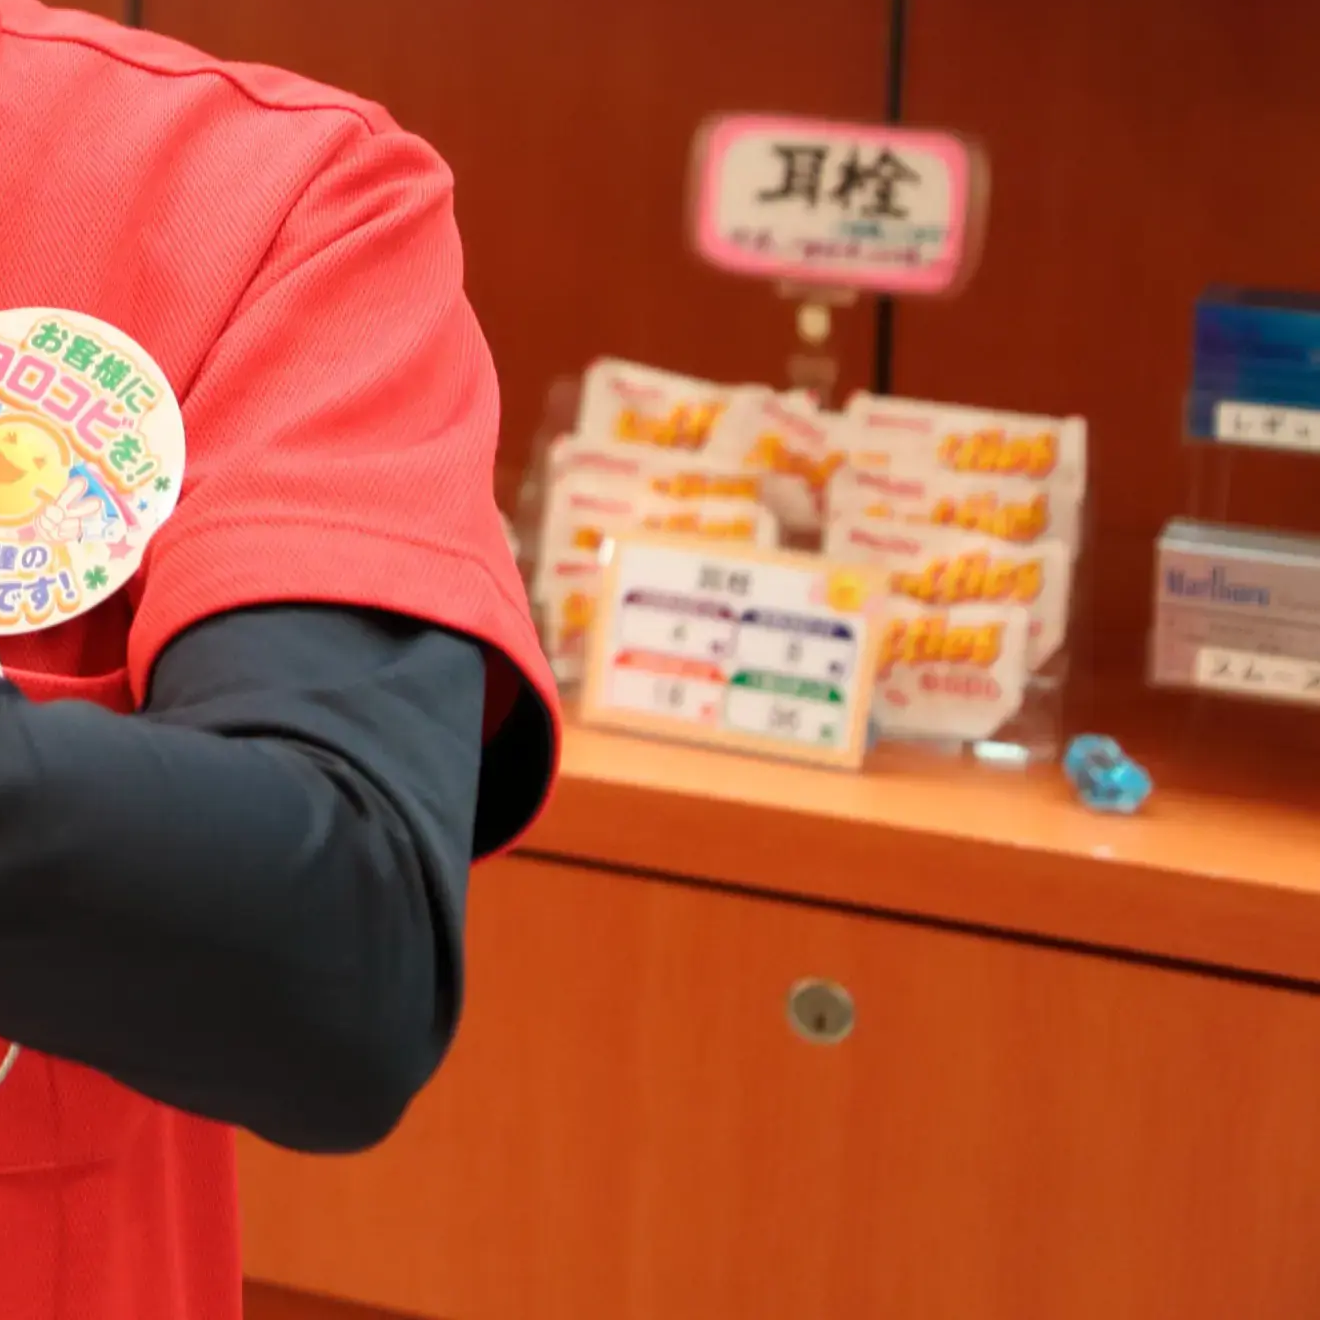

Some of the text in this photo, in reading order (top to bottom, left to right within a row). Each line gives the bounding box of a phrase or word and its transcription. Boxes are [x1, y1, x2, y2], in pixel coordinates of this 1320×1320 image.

[757, 143, 923, 221] 耳栓
[31, 321, 157, 417] お客様に
